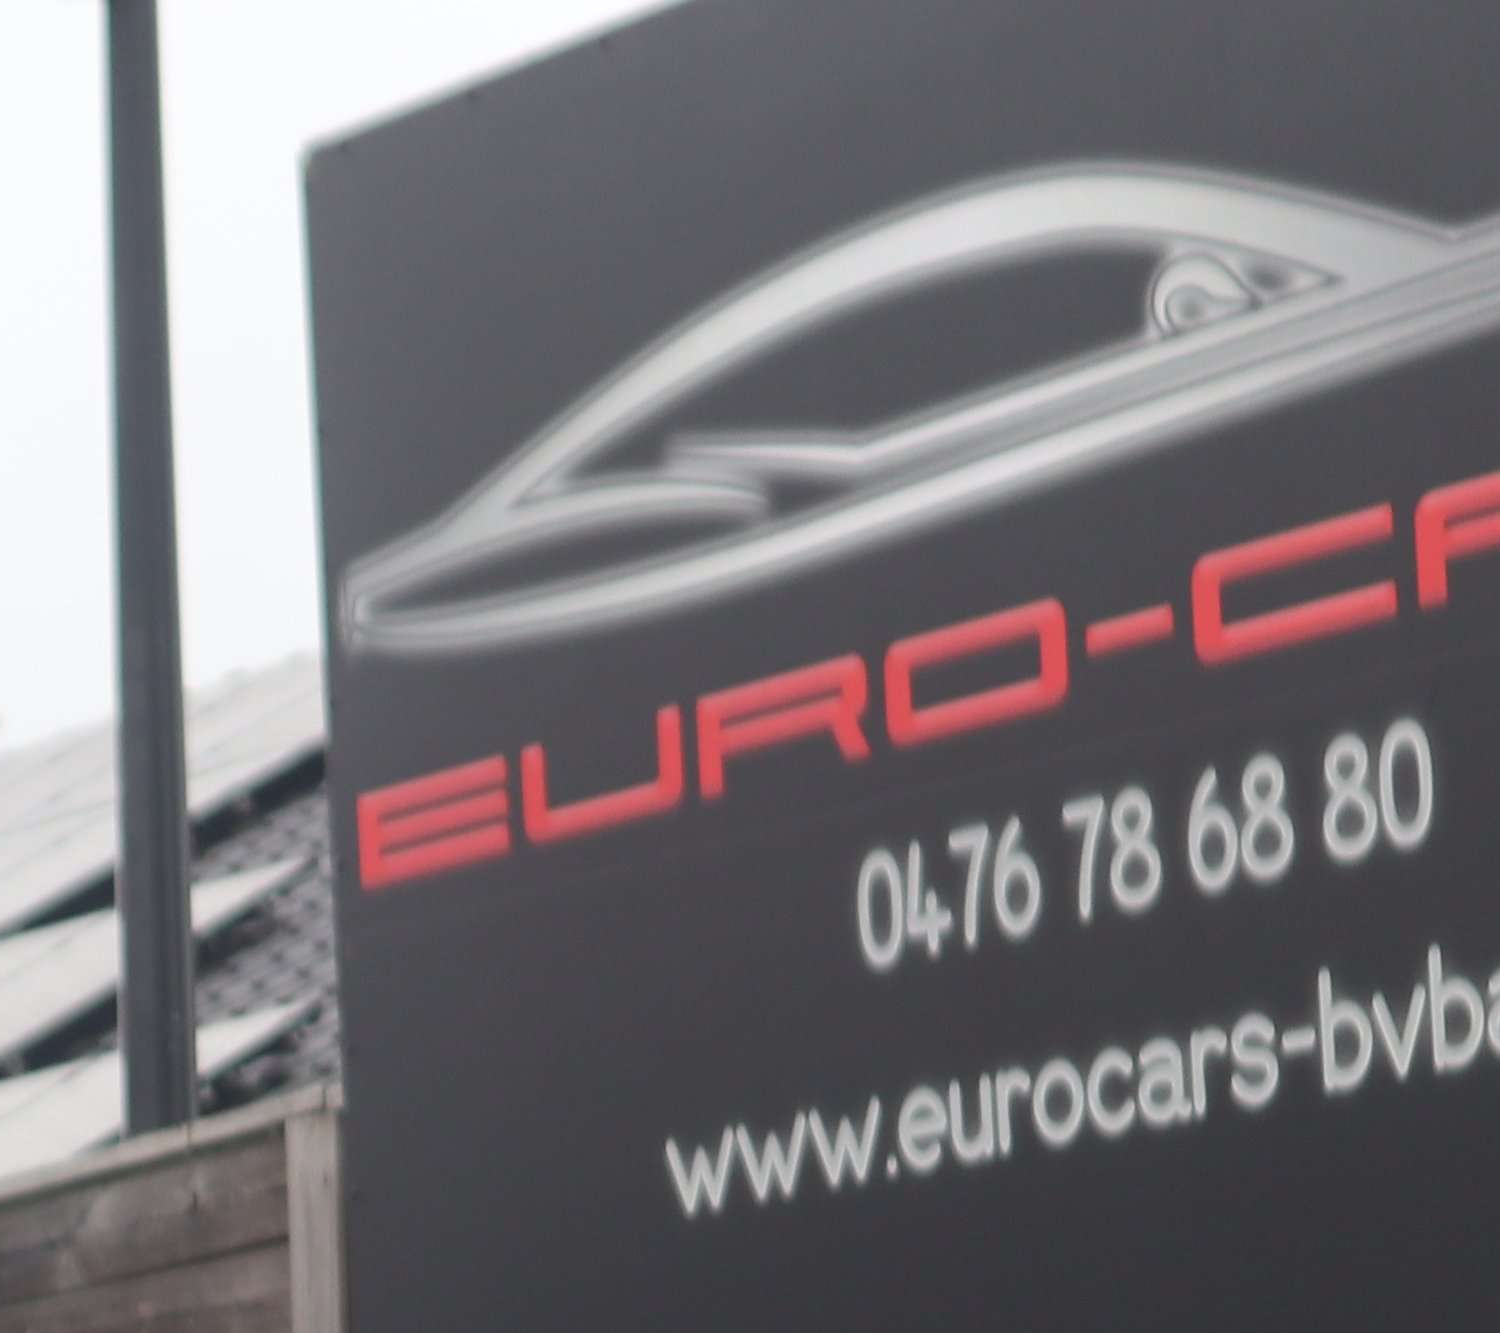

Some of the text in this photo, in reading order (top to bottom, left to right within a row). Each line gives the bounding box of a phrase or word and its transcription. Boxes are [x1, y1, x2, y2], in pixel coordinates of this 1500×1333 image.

[855, 717, 1435, 972] 0476 78 68 80
